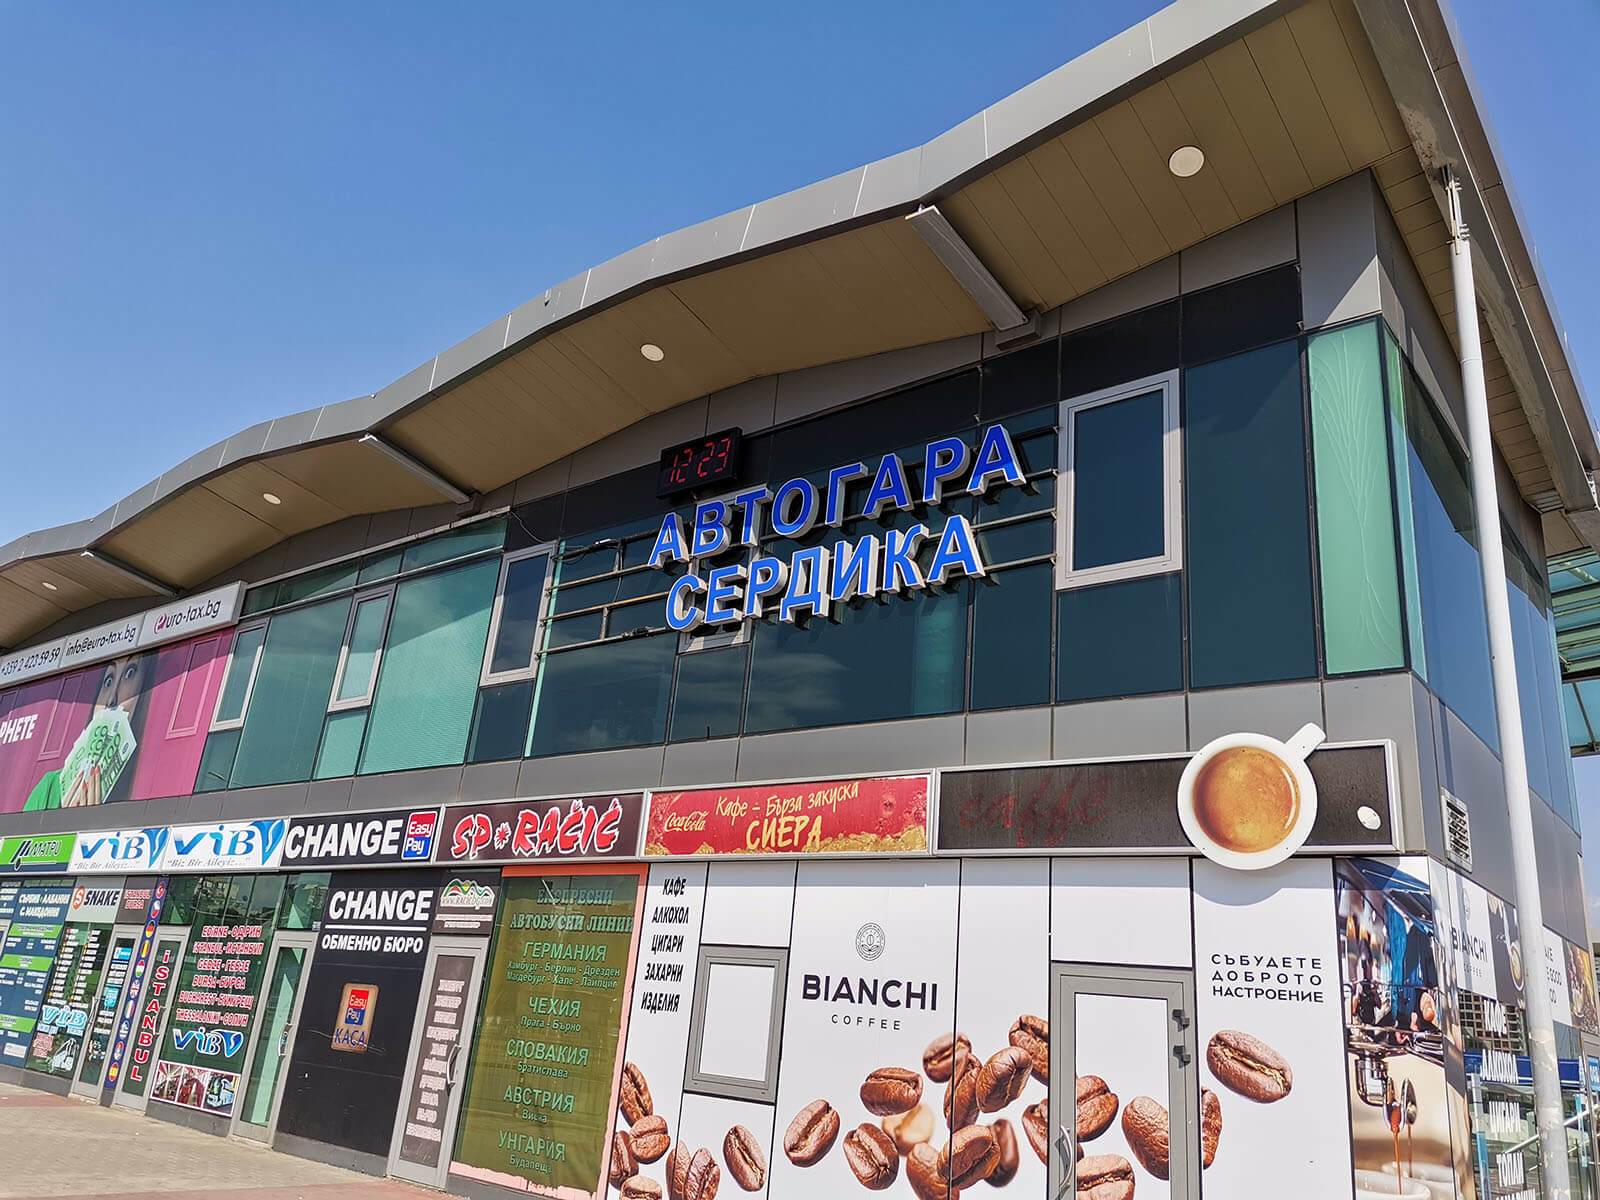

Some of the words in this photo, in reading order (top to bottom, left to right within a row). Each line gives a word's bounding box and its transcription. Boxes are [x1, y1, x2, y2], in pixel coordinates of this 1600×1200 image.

[647, 422, 1028, 568] АВТОГАРА
[664, 513, 986, 633] СЕРДИКА
[65, 622, 137, 657] info@euro-tax.bg
[715, 796, 748, 825] Кафе
[766, 794, 804, 818] Бърза
[807, 782, 859, 813] закуска
[285, 819, 404, 858] CHANGE
[409, 821, 433, 837] Easy
[745, 815, 823, 850] СИЕРА
[405, 837, 425, 855] Pay
[84, 888, 121, 906] SNAKE
[662, 878, 687, 897] КАФЕ
[329, 890, 433, 921] CHANGE
[652, 906, 689, 924] АЛКОХОЛ
[509, 913, 584, 932] АВТОБУСНИ
[322, 934, 381, 952] ОБМЕННО
[384, 936, 423, 954] БЮРО
[523, 941, 607, 962] ГЕРМАНИЯ
[651, 934, 684, 954] ЦИГАРИ
[1451, 926, 1488, 963] BIANCHI
[544, 963, 577, 973] Берлин
[583, 965, 620, 976] Дрезден
[1211, 953, 1322, 970] СЪБУДЕТЕ
[553, 974, 574, 985] Хале
[644, 963, 684, 982] ЗАХАРНИ
[1211, 970, 1322, 986] ДОБРОТО
[640, 991, 680, 1013] ИЗДЕЛИЯ
[802, 974, 938, 1011] BIANCHI
[1212, 985, 1324, 1003] НАСТРОЕНИЕ
[528, 996, 581, 1018] ЧЕХИЯ
[520, 1015, 545, 1028] Прага
[552, 1019, 581, 1032] Бърно
[831, 1014, 901, 1030] COFFEE
[1484, 1000, 1508, 1036] КАФЕ
[334, 1028, 367, 1047] КАСА
[506, 1038, 589, 1067] СЛОВАКИЯ
[517, 1061, 568, 1078] Братислава
[1481, 1049, 1519, 1084] АЛКОХОЛ
[504, 1085, 575, 1112] АВСТРИЯ
[1488, 1101, 1521, 1140] ЦИГАРИ
[498, 1130, 566, 1162] УНГАРИЯ
